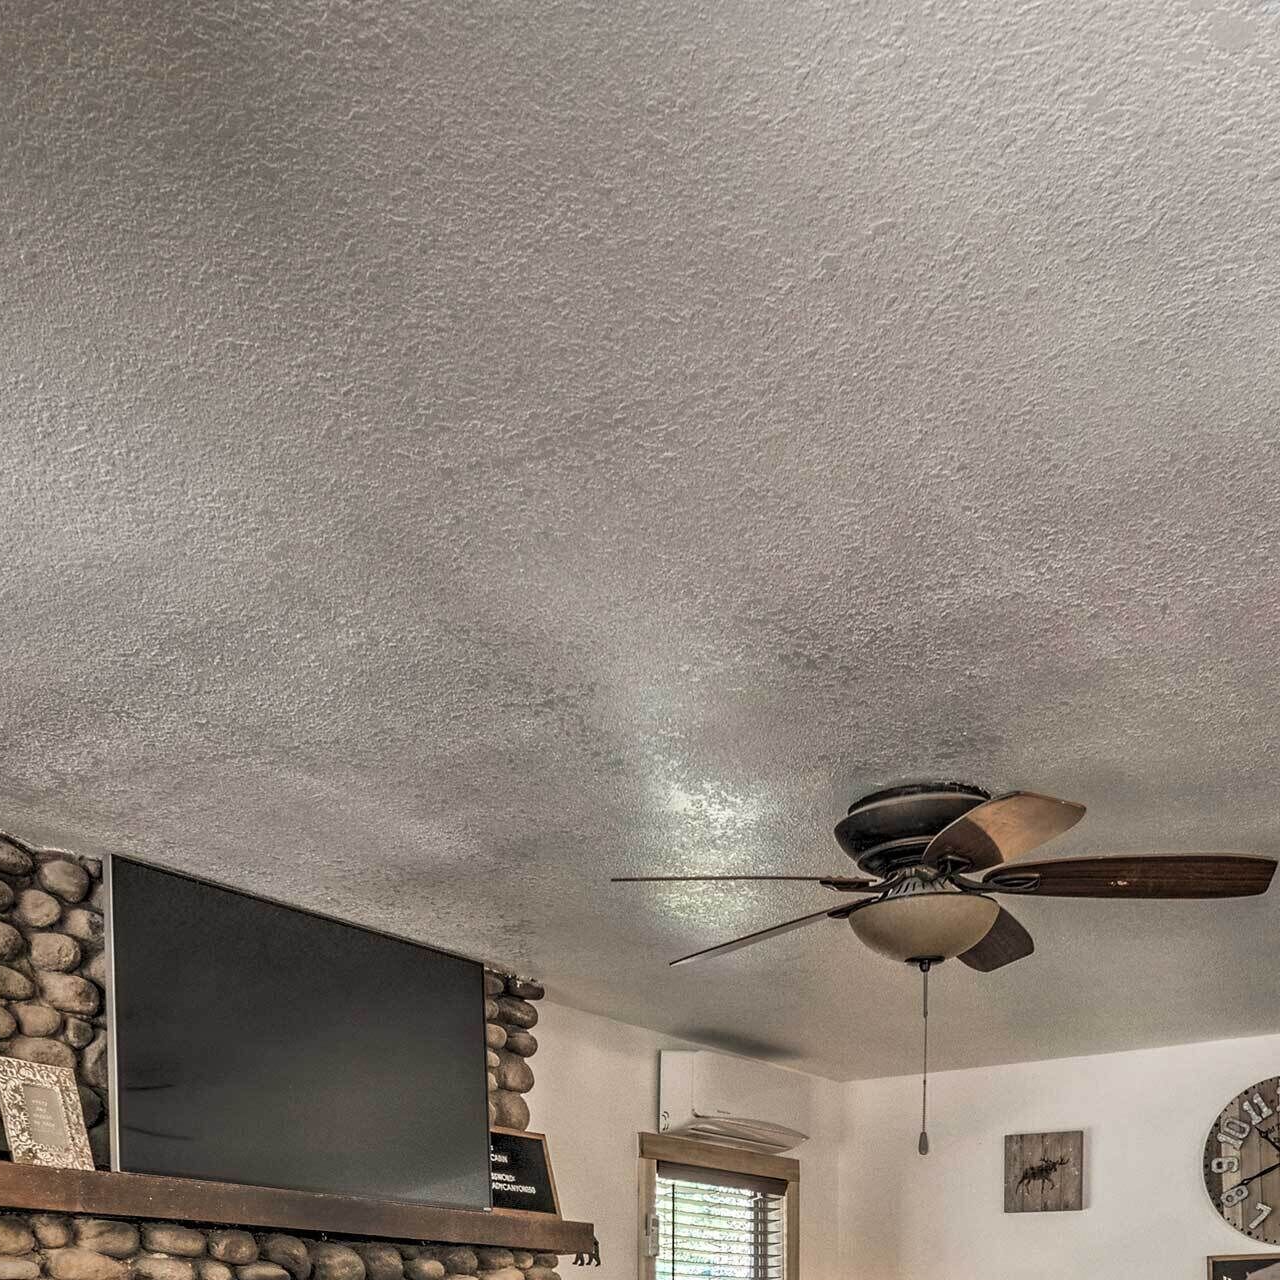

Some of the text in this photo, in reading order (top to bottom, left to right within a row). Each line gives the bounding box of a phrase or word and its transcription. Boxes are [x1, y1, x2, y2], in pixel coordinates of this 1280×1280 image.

[1243, 1092, 1273, 1126] 11
[1217, 1117, 1251, 1150] 10
[1210, 1156, 1239, 1174] 9
[1220, 1184, 1249, 1208] 8
[1248, 1201, 1272, 1230] 7
